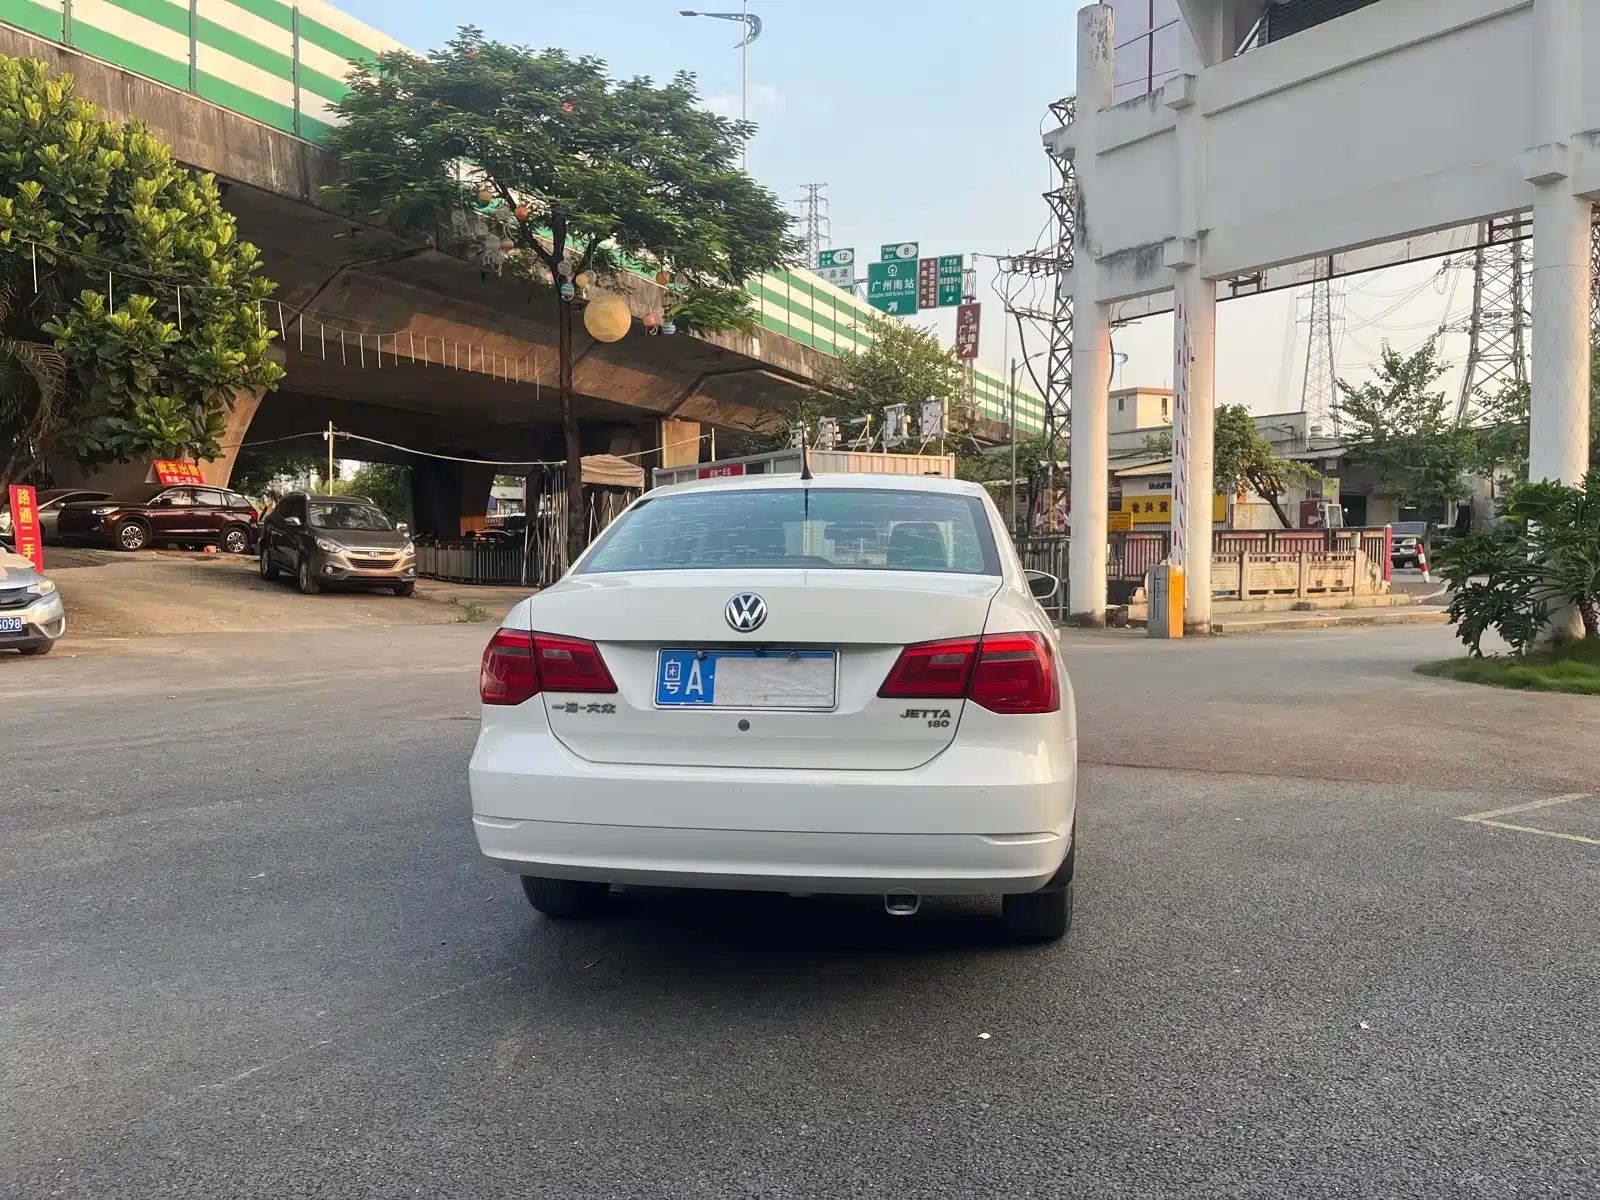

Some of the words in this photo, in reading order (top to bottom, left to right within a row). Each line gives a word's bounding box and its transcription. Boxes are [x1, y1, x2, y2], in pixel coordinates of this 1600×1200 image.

[903, 247, 910, 256] 8
[871, 277, 915, 293] 广州南站
[958, 323, 978, 335] 广州
[958, 333, 977, 345] 长隆
[156, 461, 200, 477] 此车出售
[900, 709, 951, 718] JETTA
[927, 720, 950, 728] 180
